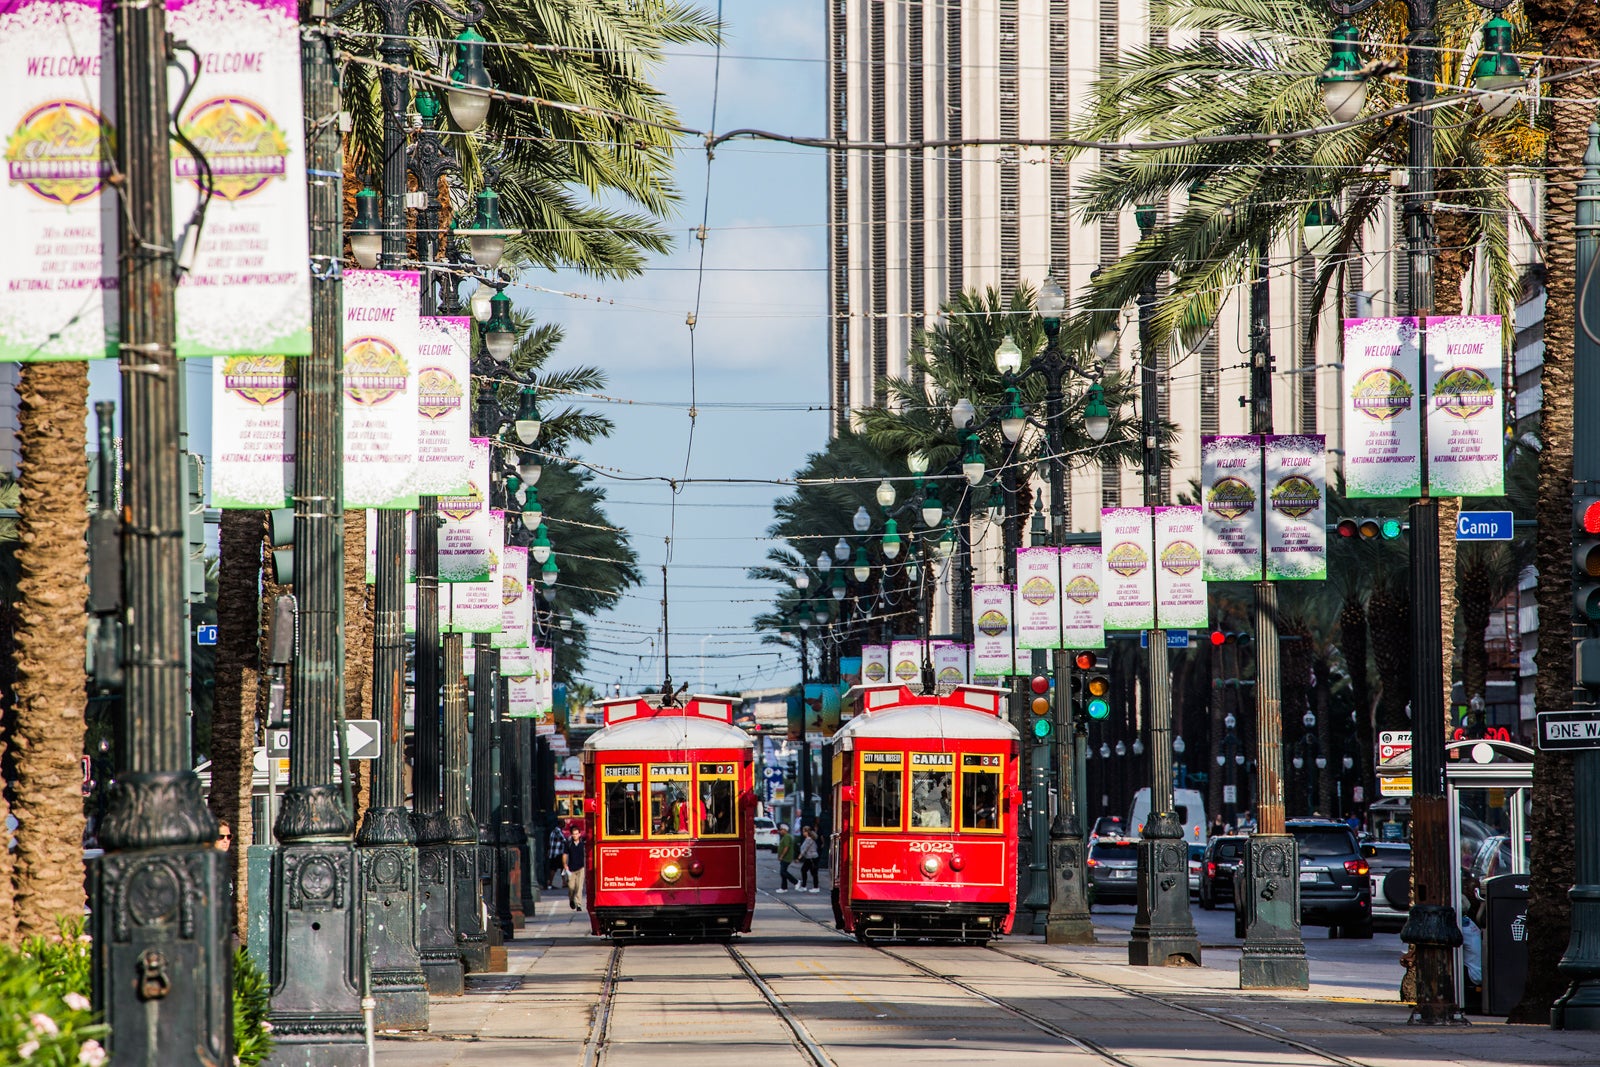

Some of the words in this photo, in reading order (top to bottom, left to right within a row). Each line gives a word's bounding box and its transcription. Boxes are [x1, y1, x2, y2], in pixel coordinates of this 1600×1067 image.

[27, 56, 102, 77] WELCOME
[222, 272, 297, 286] CHAMPIONSHIPS
[8, 278, 51, 291] NATIONAL
[347, 307, 397, 322] WELCOME
[1365, 345, 1401, 356] WELCOME
[1447, 343, 1484, 355] WELCOME
[1375, 438, 1401, 446] VOLLEYBALL
[1458, 437, 1483, 445] VOLLEYBALL
[221, 453, 251, 462] NATIONAL
[425, 455, 464, 463] CHAMPIONSHIPS
[1281, 457, 1312, 466] WELCOME
[1351, 456, 1375, 464] NATIONAL
[1376, 455, 1415, 464] CHAMPIONSHIPS
[1458, 454, 1498, 462] CHAMPIONSHIPS
[1217, 459, 1247, 468] WELCOME
[1115, 526, 1140, 534] WELCOME
[1169, 525, 1194, 533] WELCOME
[1459, 516, 1498, 537] Camp
[503, 562, 518, 570] LCOME
[1551, 723, 1581, 738] ONE
[864, 754, 873, 762] CITY
[912, 754, 952, 765] CANAL
[605, 766, 640, 776] CEMETERIES
[909, 842, 954, 853] 2022
[649, 848, 692, 859] 2003
